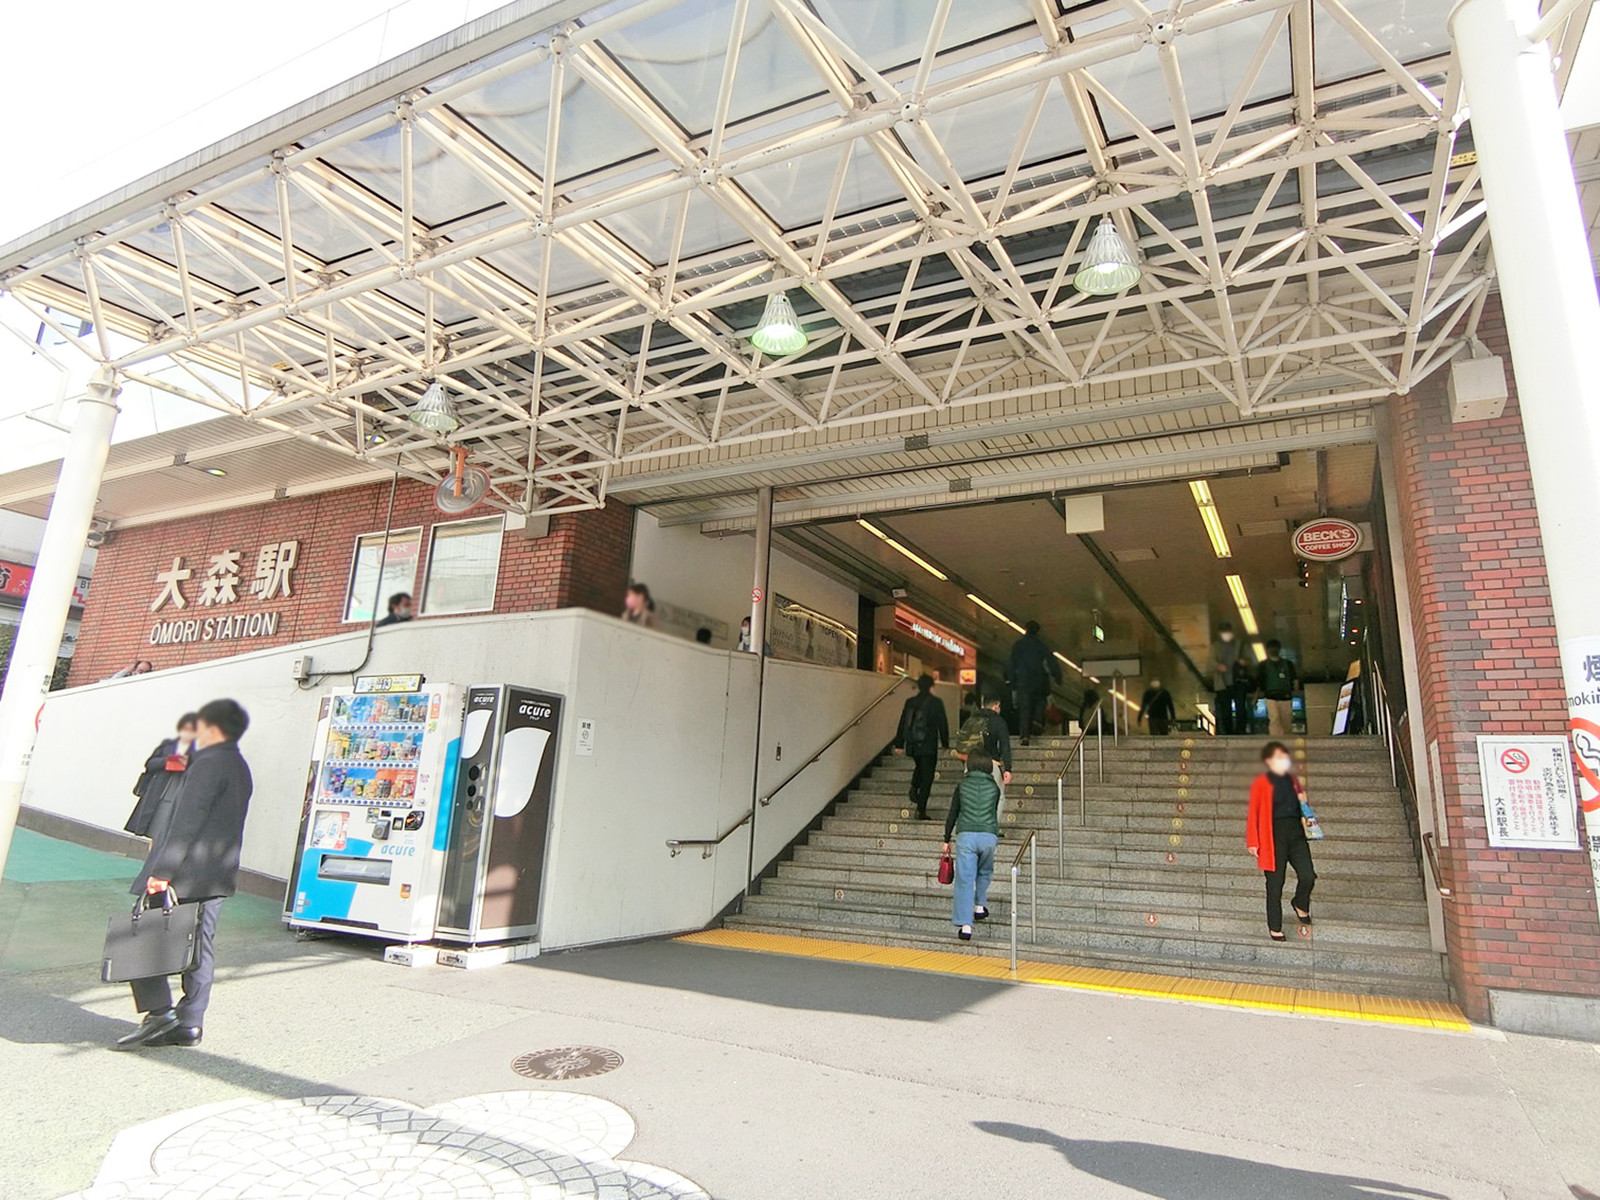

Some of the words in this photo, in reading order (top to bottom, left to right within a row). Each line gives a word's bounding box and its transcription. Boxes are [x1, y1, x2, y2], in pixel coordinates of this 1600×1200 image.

[1303, 528, 1351, 541] BECK'S
[1304, 543, 1331, 551] COFFEE
[151, 540, 299, 612] 大森駅
[202, 612, 279, 641] STATION
[473, 695, 495, 703] acure
[518, 704, 552, 718] acure
[1494, 797, 1509, 837] 大森駅長
[381, 844, 415, 857] acure
